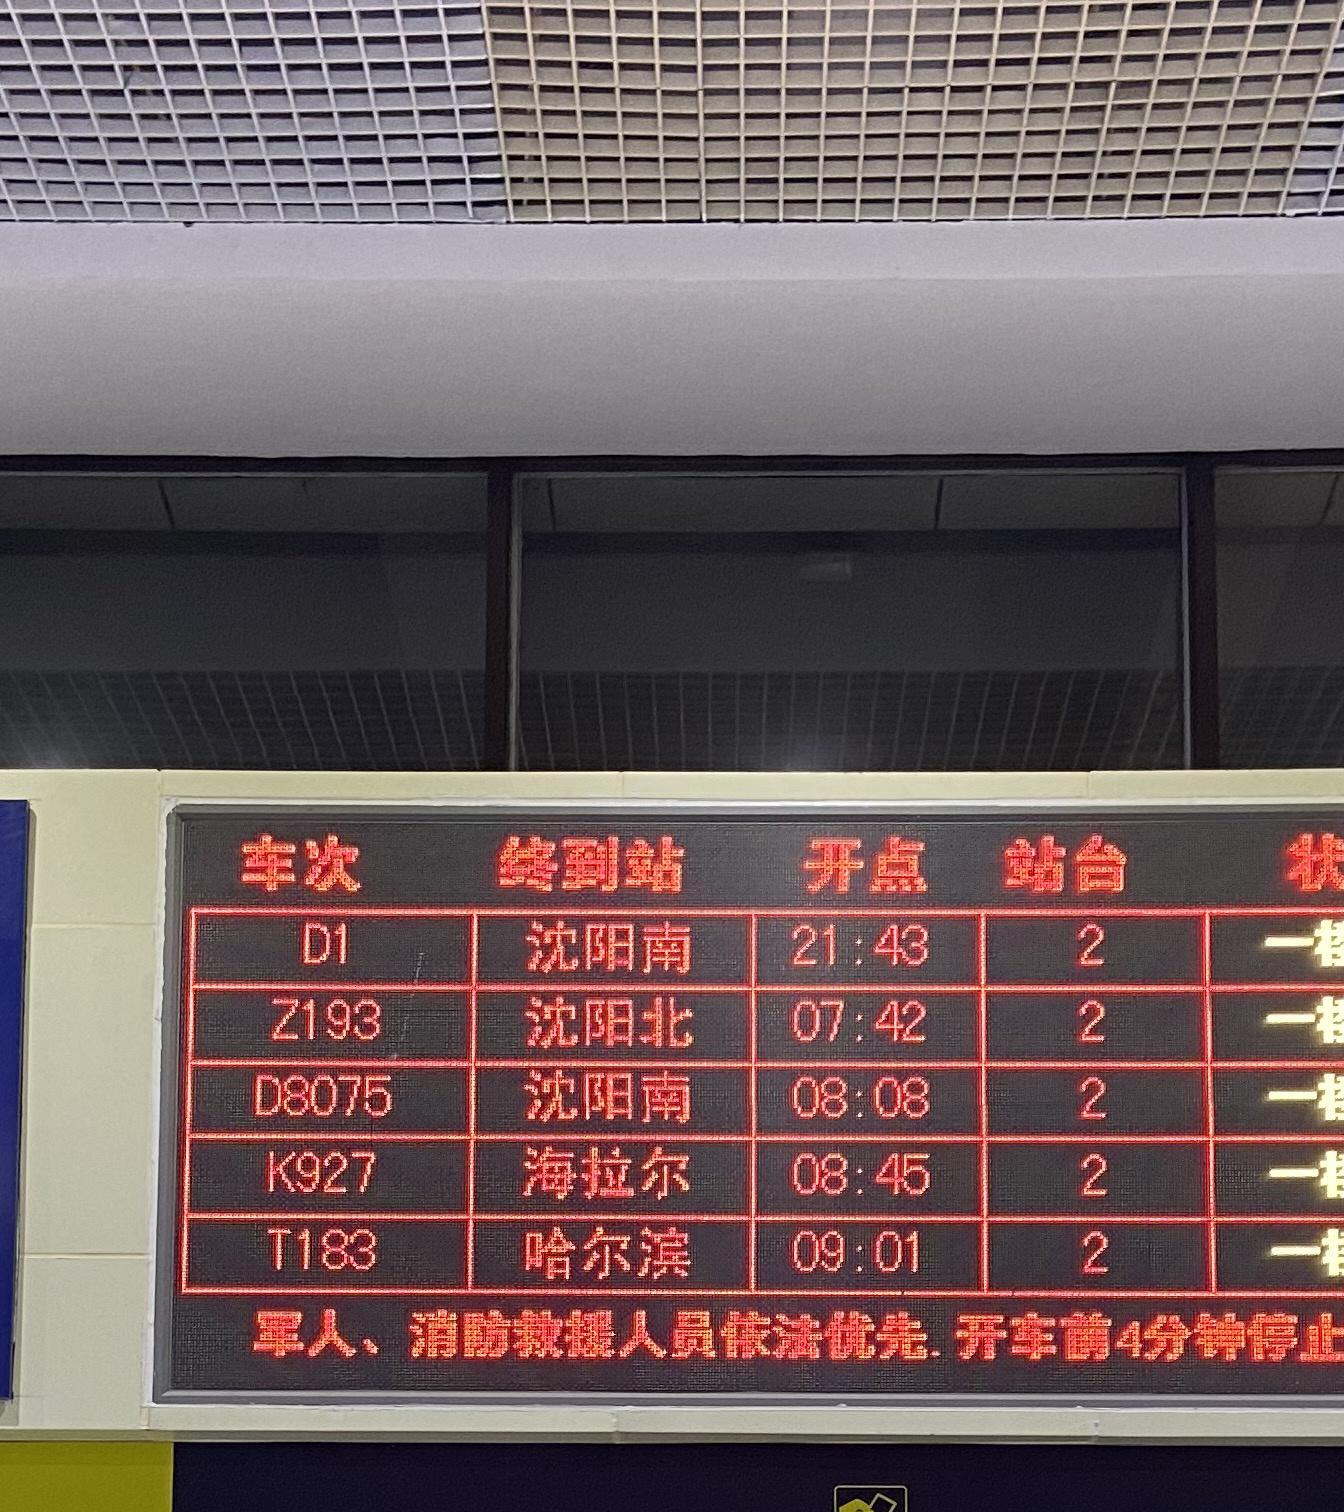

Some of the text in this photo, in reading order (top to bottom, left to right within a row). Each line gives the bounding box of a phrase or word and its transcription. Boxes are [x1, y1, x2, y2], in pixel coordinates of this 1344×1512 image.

[240, 833, 362, 893] 车次
[497, 834, 685, 895] 终到站
[801, 835, 928, 895] 开点
[1003, 833, 1128, 894] 站台
[302, 921, 349, 966] D1
[524, 916, 693, 975] 沈阳南
[790, 921, 930, 968] 21:43
[1076, 920, 1106, 968] 2
[270, 996, 382, 1043] Z193
[523, 992, 694, 1049] 沈阳北
[790, 997, 928, 1045] 07:42
[1077, 998, 1106, 1044] 2
[253, 1070, 393, 1119] D8075
[523, 1068, 692, 1125] 沈阳南
[790, 1075, 930, 1121] 08:08
[1078, 1075, 1107, 1121] 2
[266, 1149, 376, 1195] K927
[521, 1144, 690, 1201] 海拉尔
[790, 1151, 932, 1196] 08:45
[1079, 1152, 1108, 1198] 2
[266, 1226, 377, 1272] T183
[524, 1226, 690, 1281] 哈尔滨
[790, 1229, 926, 1275] 09:01
[1081, 1229, 1109, 1276] 2
